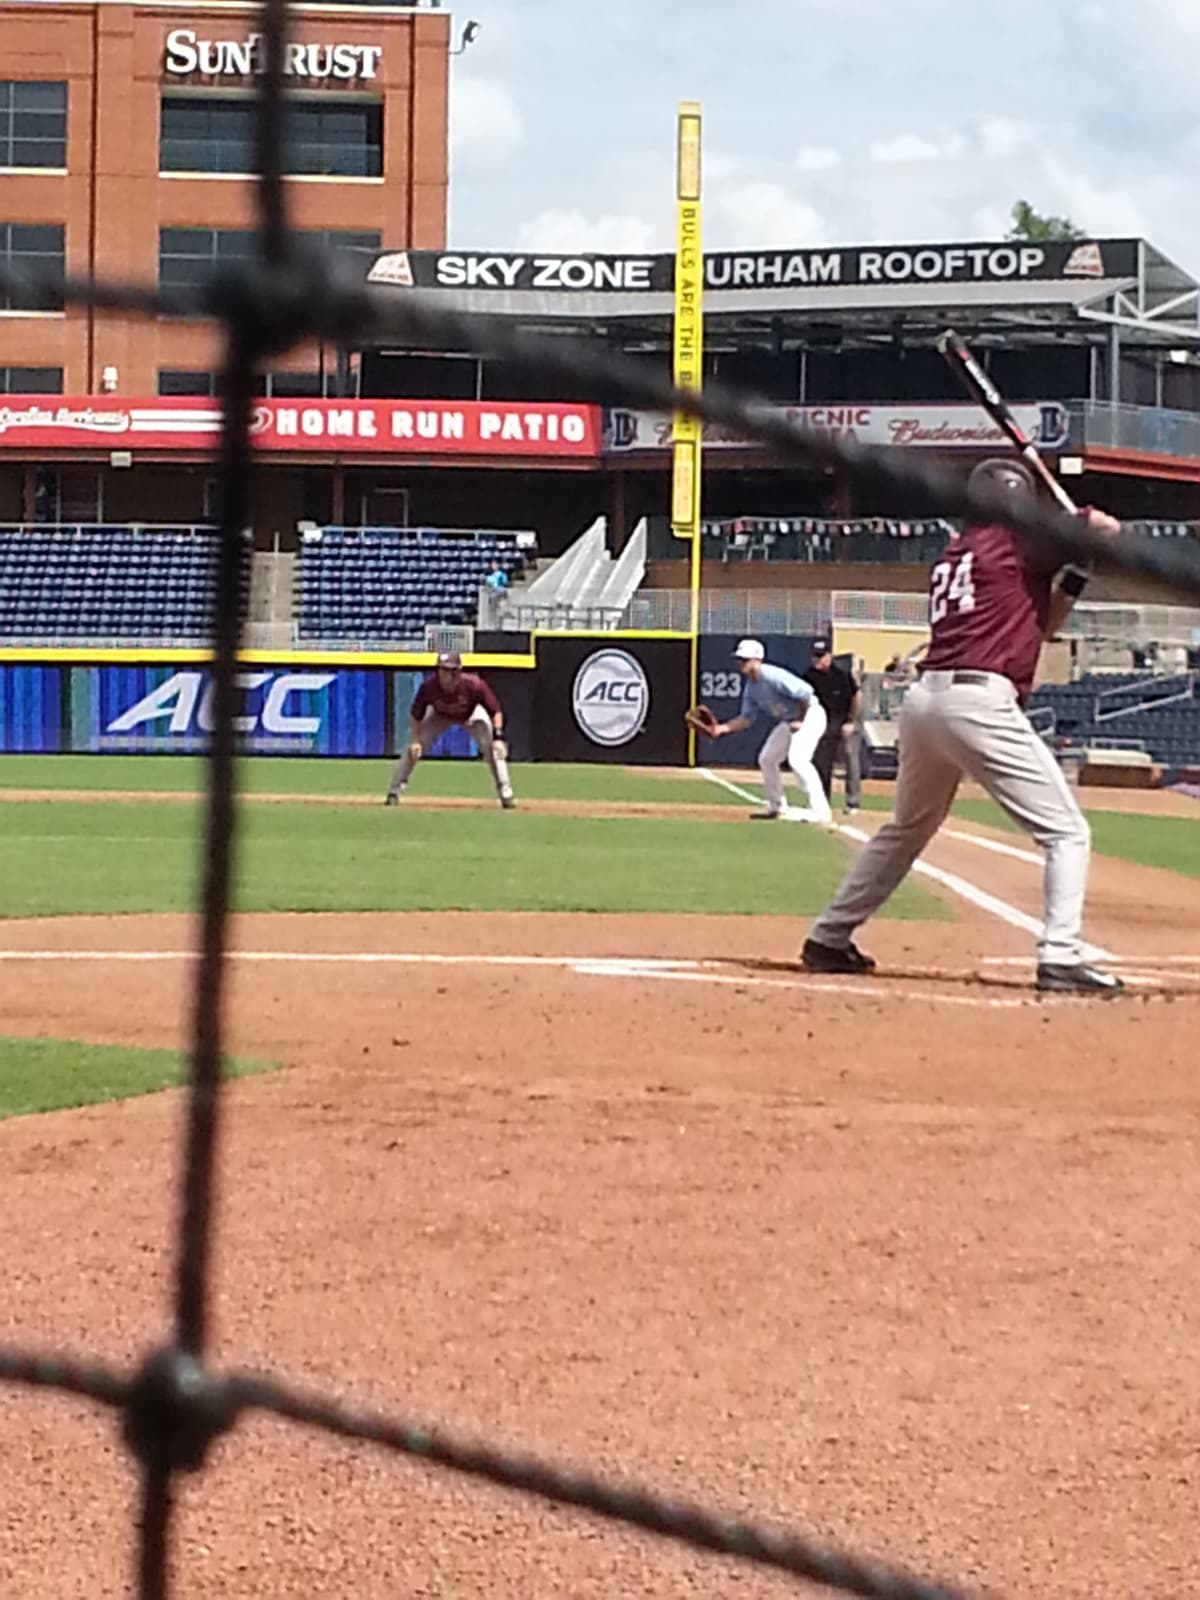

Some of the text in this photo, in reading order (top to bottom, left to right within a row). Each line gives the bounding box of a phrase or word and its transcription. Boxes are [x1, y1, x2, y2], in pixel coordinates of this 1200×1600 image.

[681, 208, 696, 269] BULLS
[436, 257, 526, 285] SKY
[532, 259, 655, 287] ZONE
[705, 248, 1045, 286] URHAM ROOFTOP
[680, 279, 695, 317] ARE
[680, 327, 694, 361] THE
[276, 408, 586, 443] HOME RUN PATIO
[931, 551, 976, 625] 24
[106, 672, 339, 733] ACC
[584, 681, 642, 702] ACC
[701, 672, 742, 697] 323
